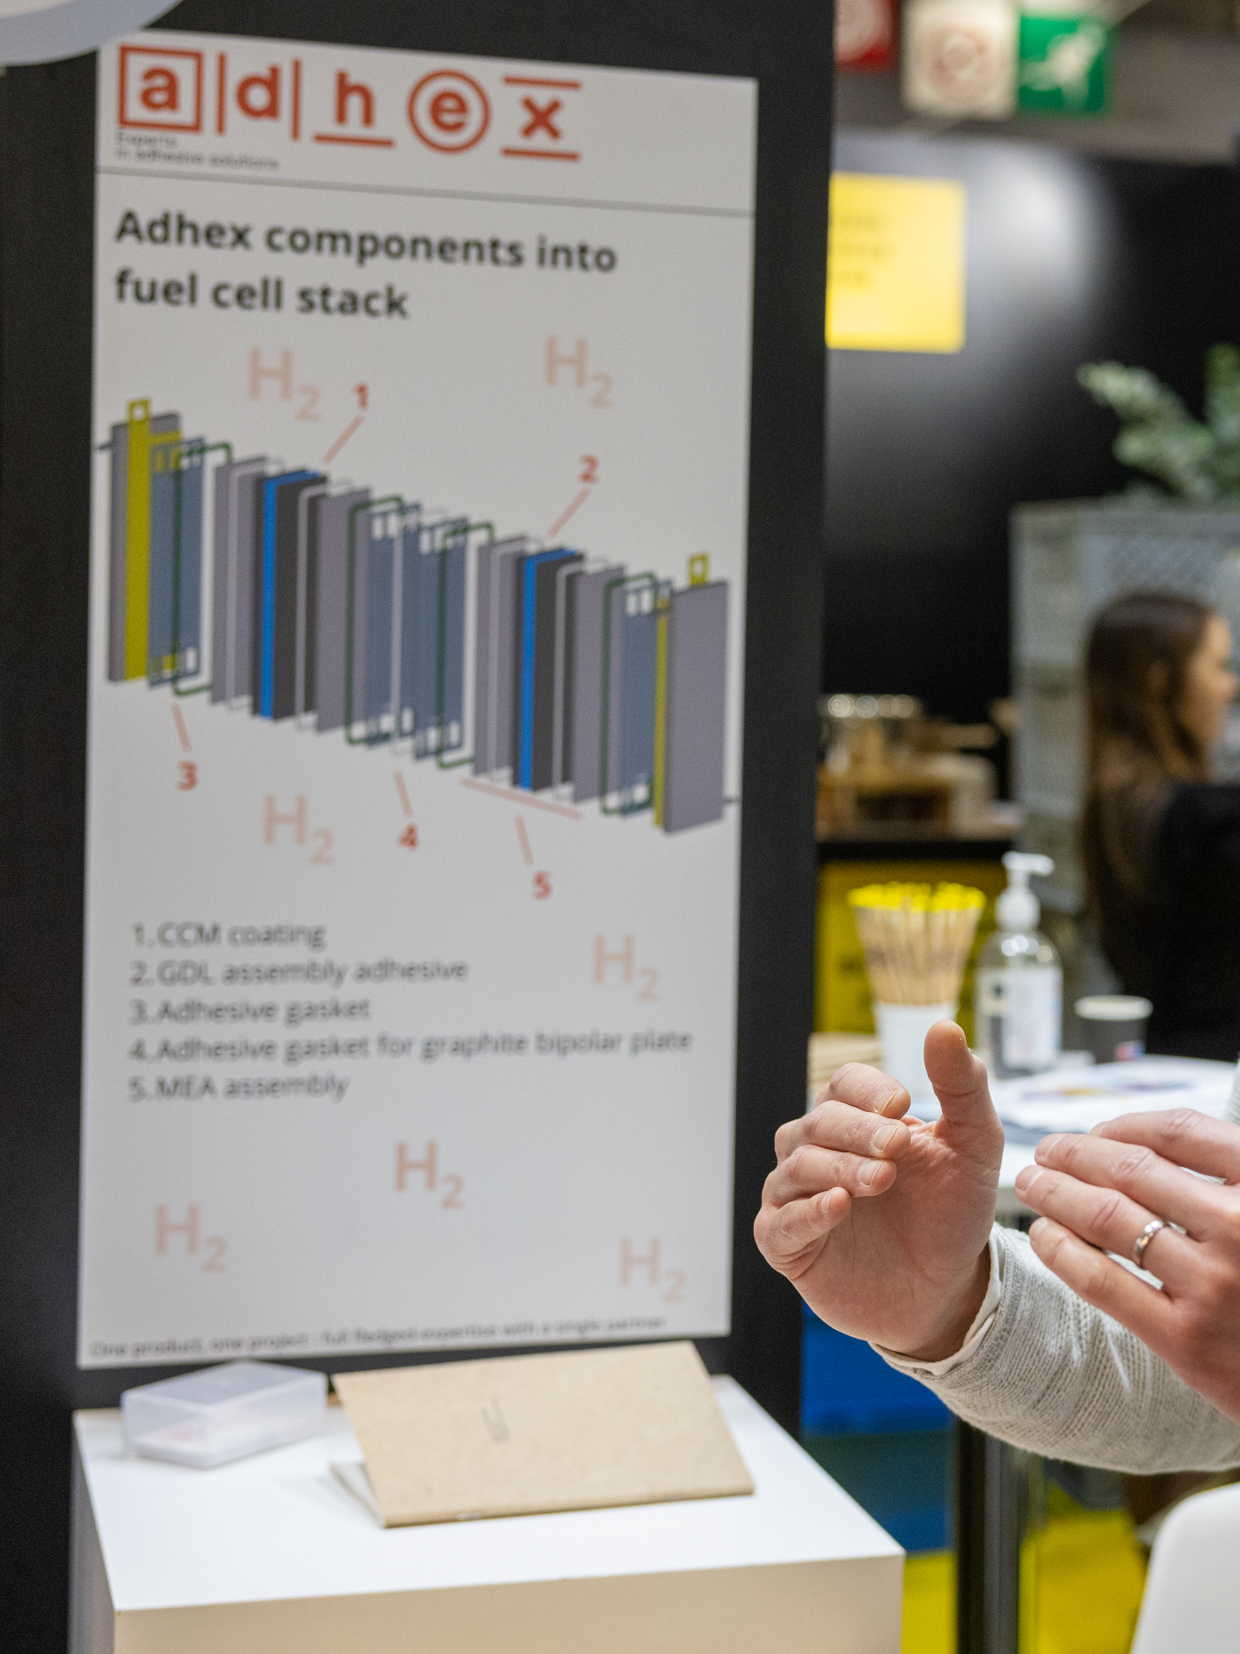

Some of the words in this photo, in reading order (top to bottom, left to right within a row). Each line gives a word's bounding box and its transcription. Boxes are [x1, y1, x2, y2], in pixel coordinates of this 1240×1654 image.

[115, 210, 250, 249] Adhex
[265, 226, 524, 268] components
[537, 236, 617, 274] into
[115, 268, 197, 306] fuel
[211, 277, 283, 310] cell
[298, 285, 407, 317] stack
[353, 382, 370, 409] 1
[577, 454, 600, 485] 2
[176, 761, 199, 792] 3
[397, 822, 421, 851] 4
[532, 870, 554, 900] 5
[227, 925, 325, 951] coating
[220, 961, 347, 987] assembly
[353, 958, 468, 982] adhesive
[284, 999, 369, 1027] gasket
[284, 1038, 369, 1065] gasket
[376, 1032, 413, 1057] for
[421, 1033, 528, 1062] graphite
[534, 1032, 622, 1057] bipolar
[630, 1031, 693, 1055] plate
[222, 1075, 348, 1100] assembly
